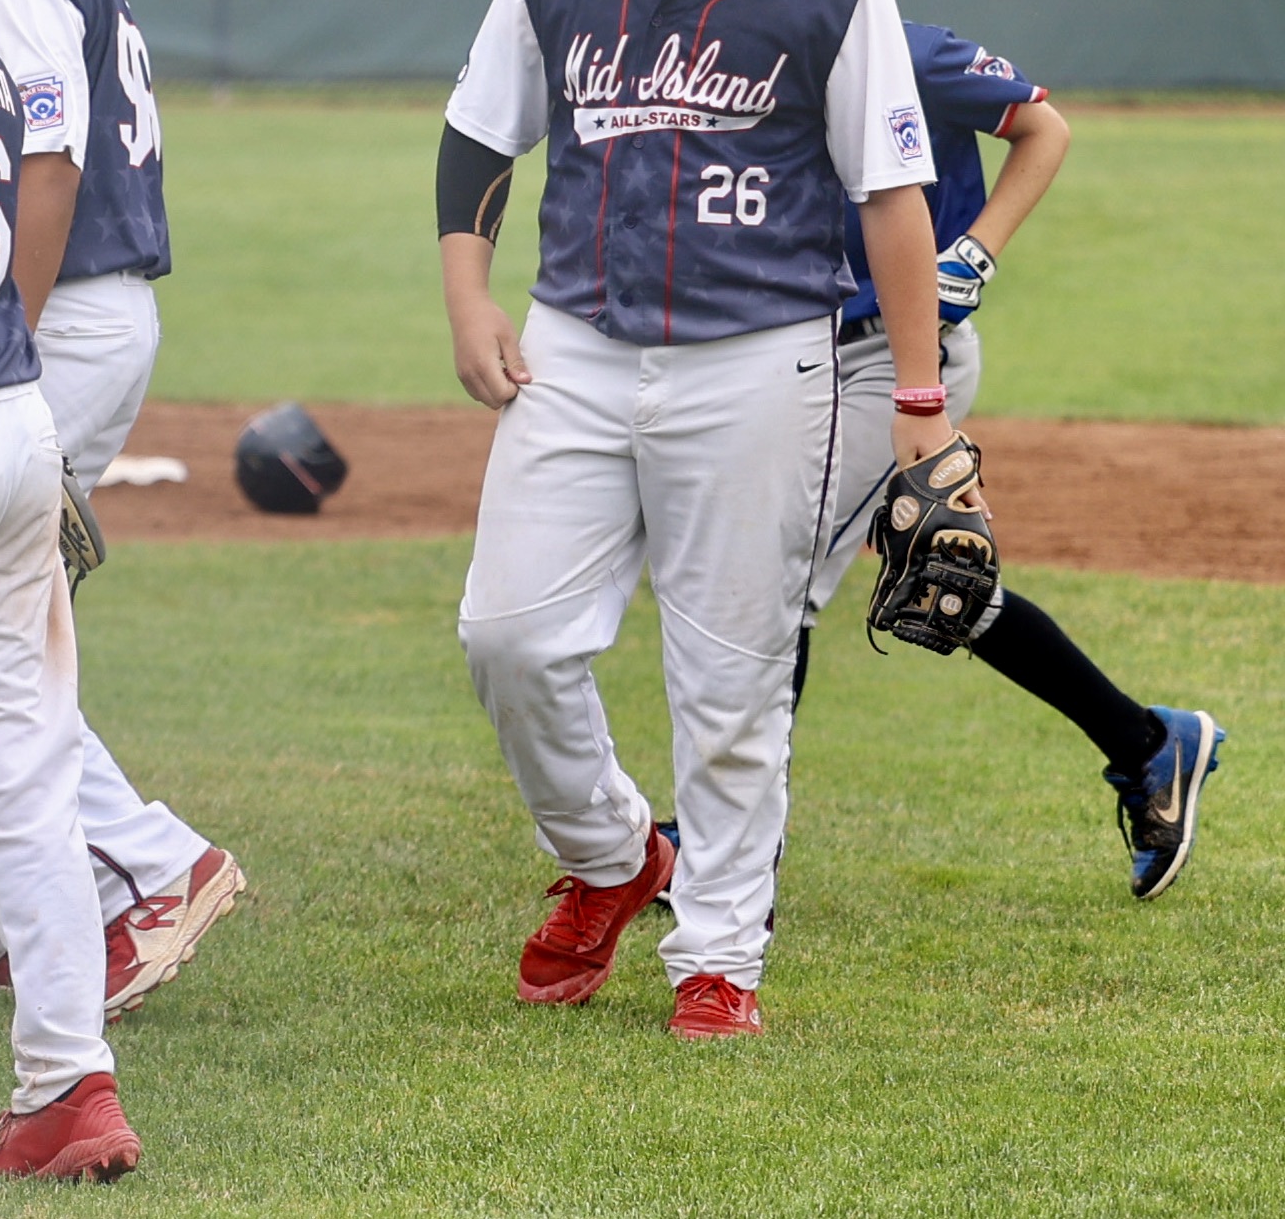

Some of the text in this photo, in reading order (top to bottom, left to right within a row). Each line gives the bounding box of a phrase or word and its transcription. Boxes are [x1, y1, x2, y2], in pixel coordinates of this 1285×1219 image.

[564, 33, 788, 113] Mid Island
[610, 111, 701, 129] ALL-STARS
[698, 164, 770, 225] 26
